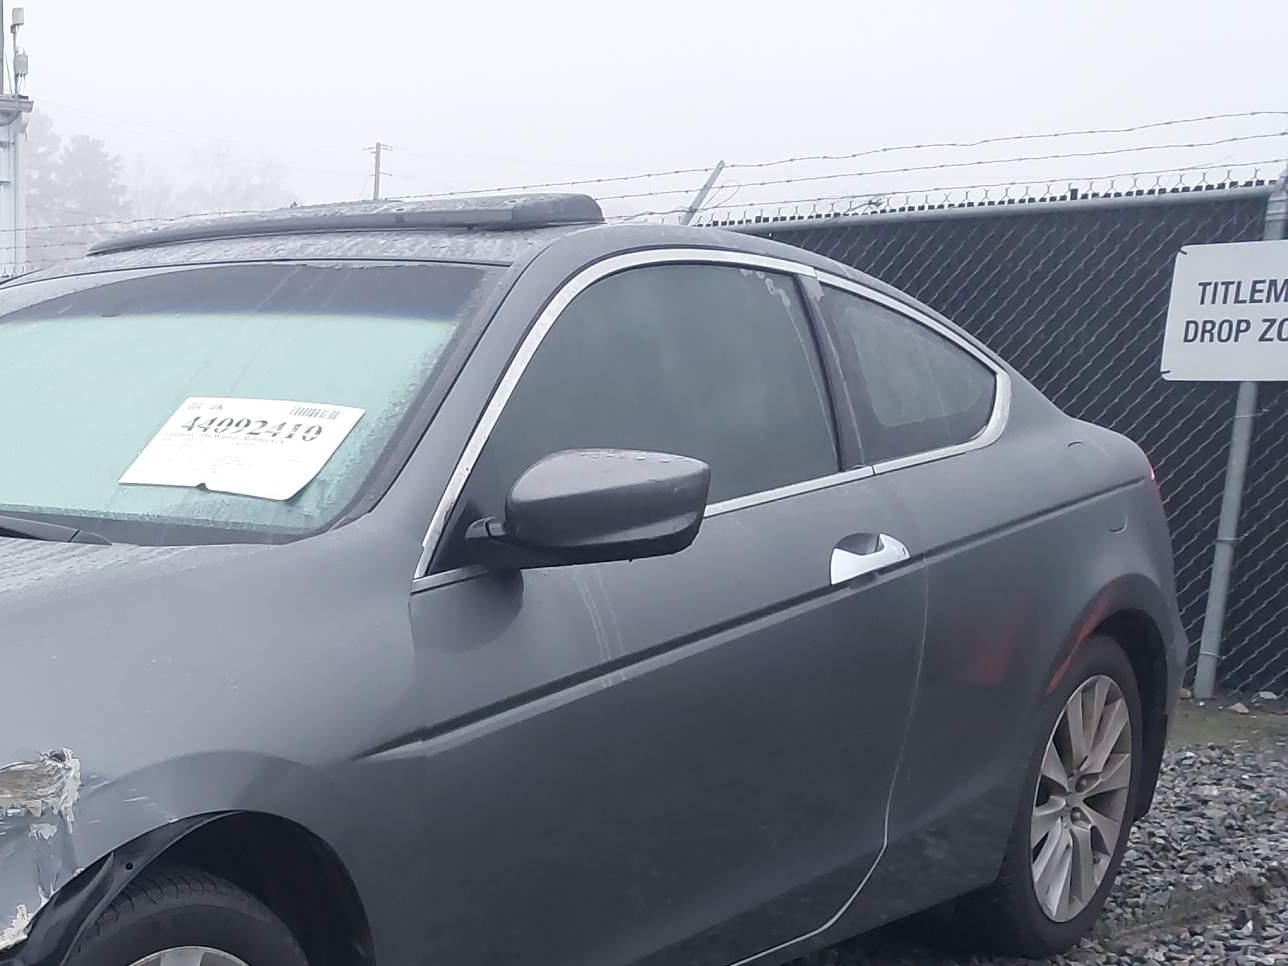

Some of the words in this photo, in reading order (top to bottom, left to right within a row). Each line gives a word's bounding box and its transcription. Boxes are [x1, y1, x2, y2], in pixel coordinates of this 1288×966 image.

[1198, 279, 1288, 305] TITLEM
[1183, 318, 1251, 343] DROP
[181, 416, 323, 442] 44092410
